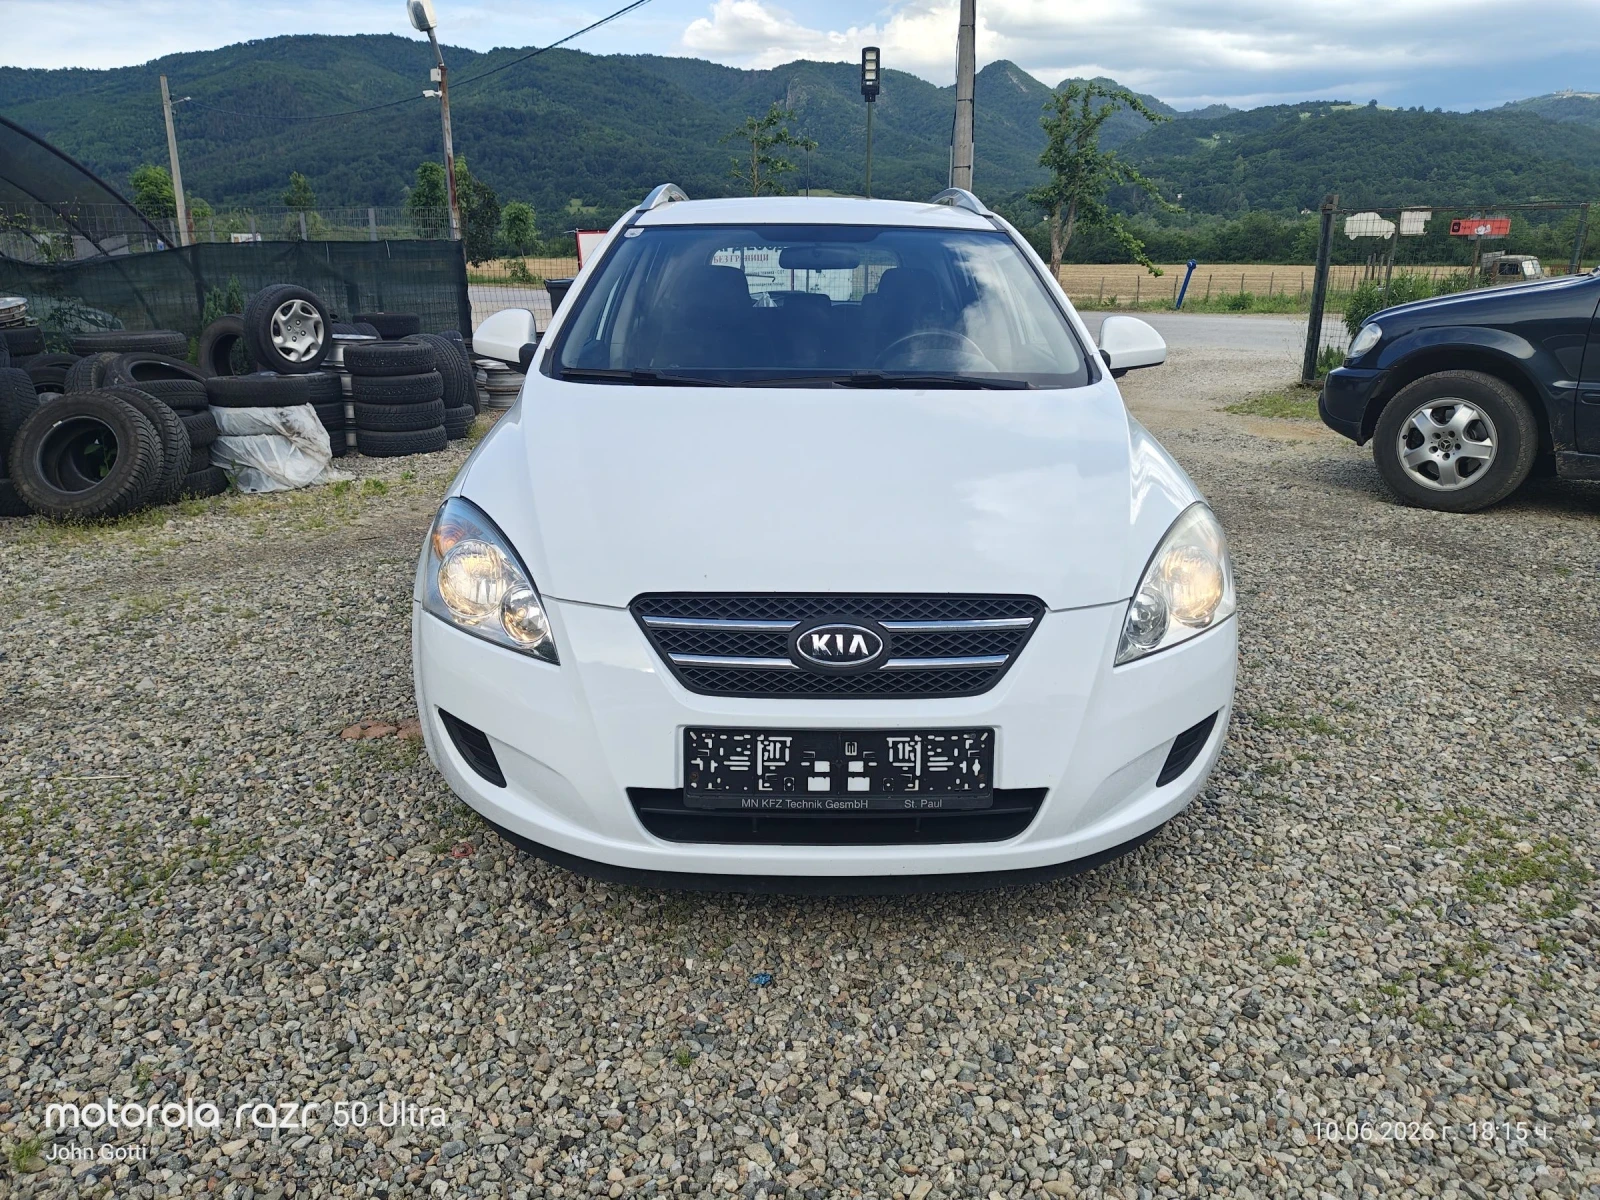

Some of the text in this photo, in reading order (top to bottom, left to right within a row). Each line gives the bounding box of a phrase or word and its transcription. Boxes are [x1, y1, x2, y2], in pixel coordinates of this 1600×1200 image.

[714, 254, 769, 264] БЕЗ ГРНИЦИ
[811, 634, 869, 656] KIA
[741, 798, 943, 809] MN KFZ Technik GesmbH St. Paul
